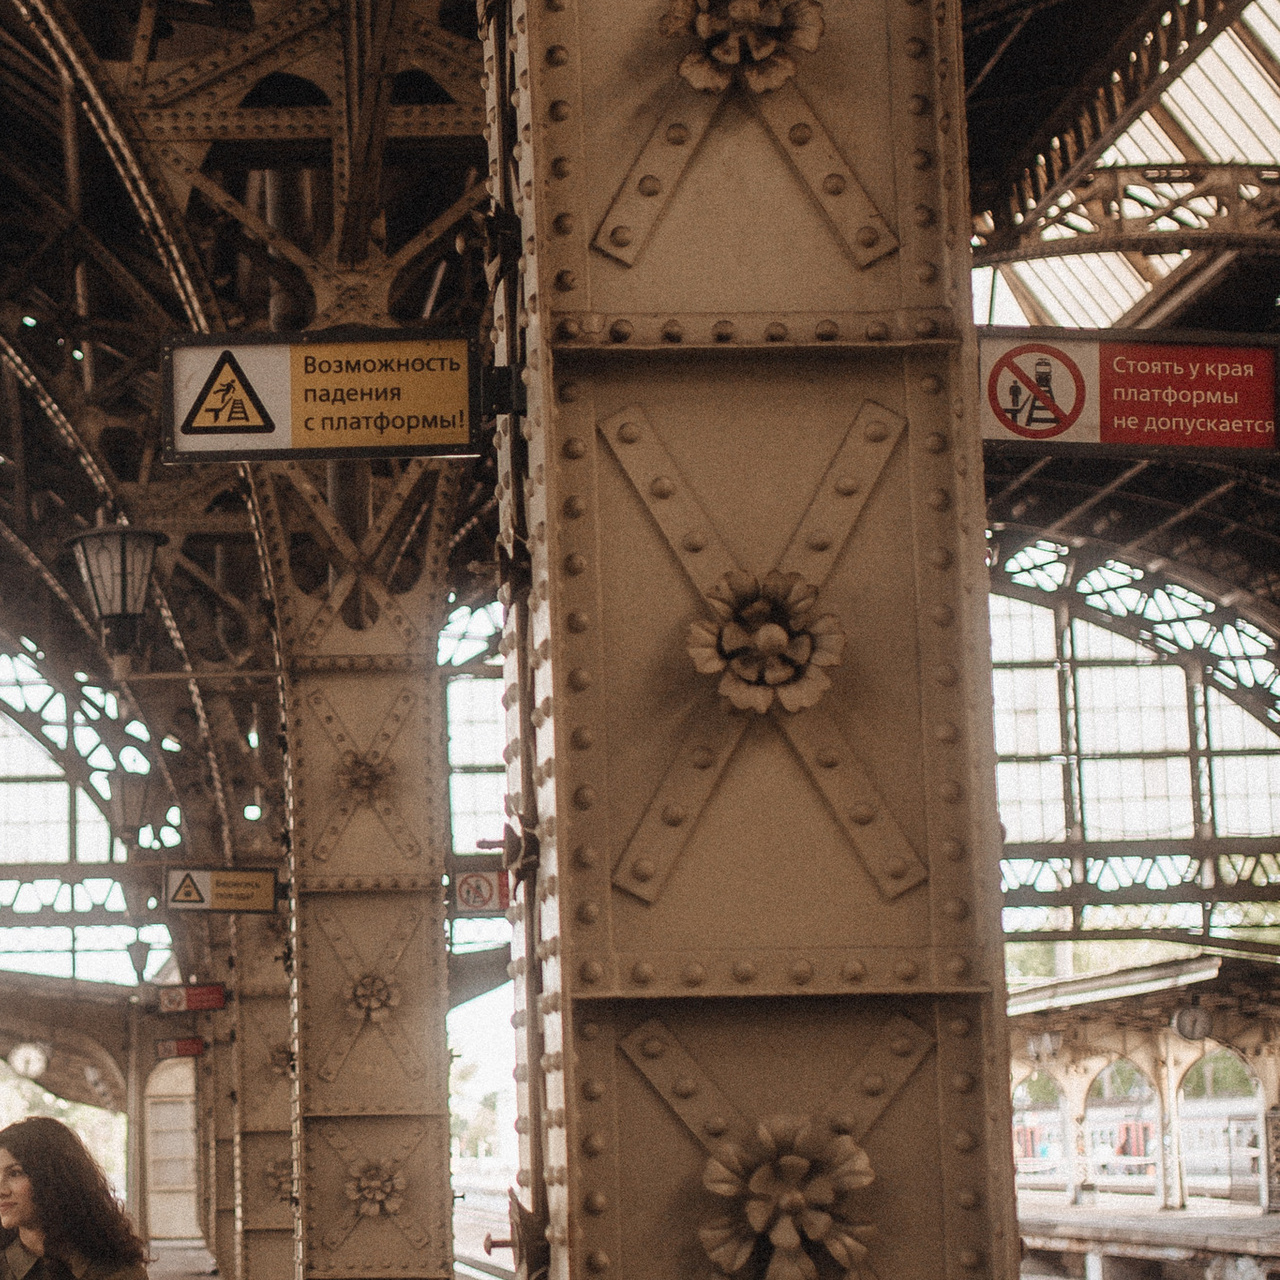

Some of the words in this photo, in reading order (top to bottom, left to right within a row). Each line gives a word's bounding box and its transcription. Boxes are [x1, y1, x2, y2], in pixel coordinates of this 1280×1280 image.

[304, 356, 460, 374] Возможность
[1113, 356, 1184, 375] Стоять
[1188, 363, 1200, 379] у
[1205, 363, 1254, 380] края
[304, 387, 401, 405] падения
[1113, 386, 1238, 407] платформы
[303, 416, 315, 431] с
[321, 410, 464, 434] платформы!
[1113, 416, 1138, 429] не
[1144, 417, 1275, 434] допускается
